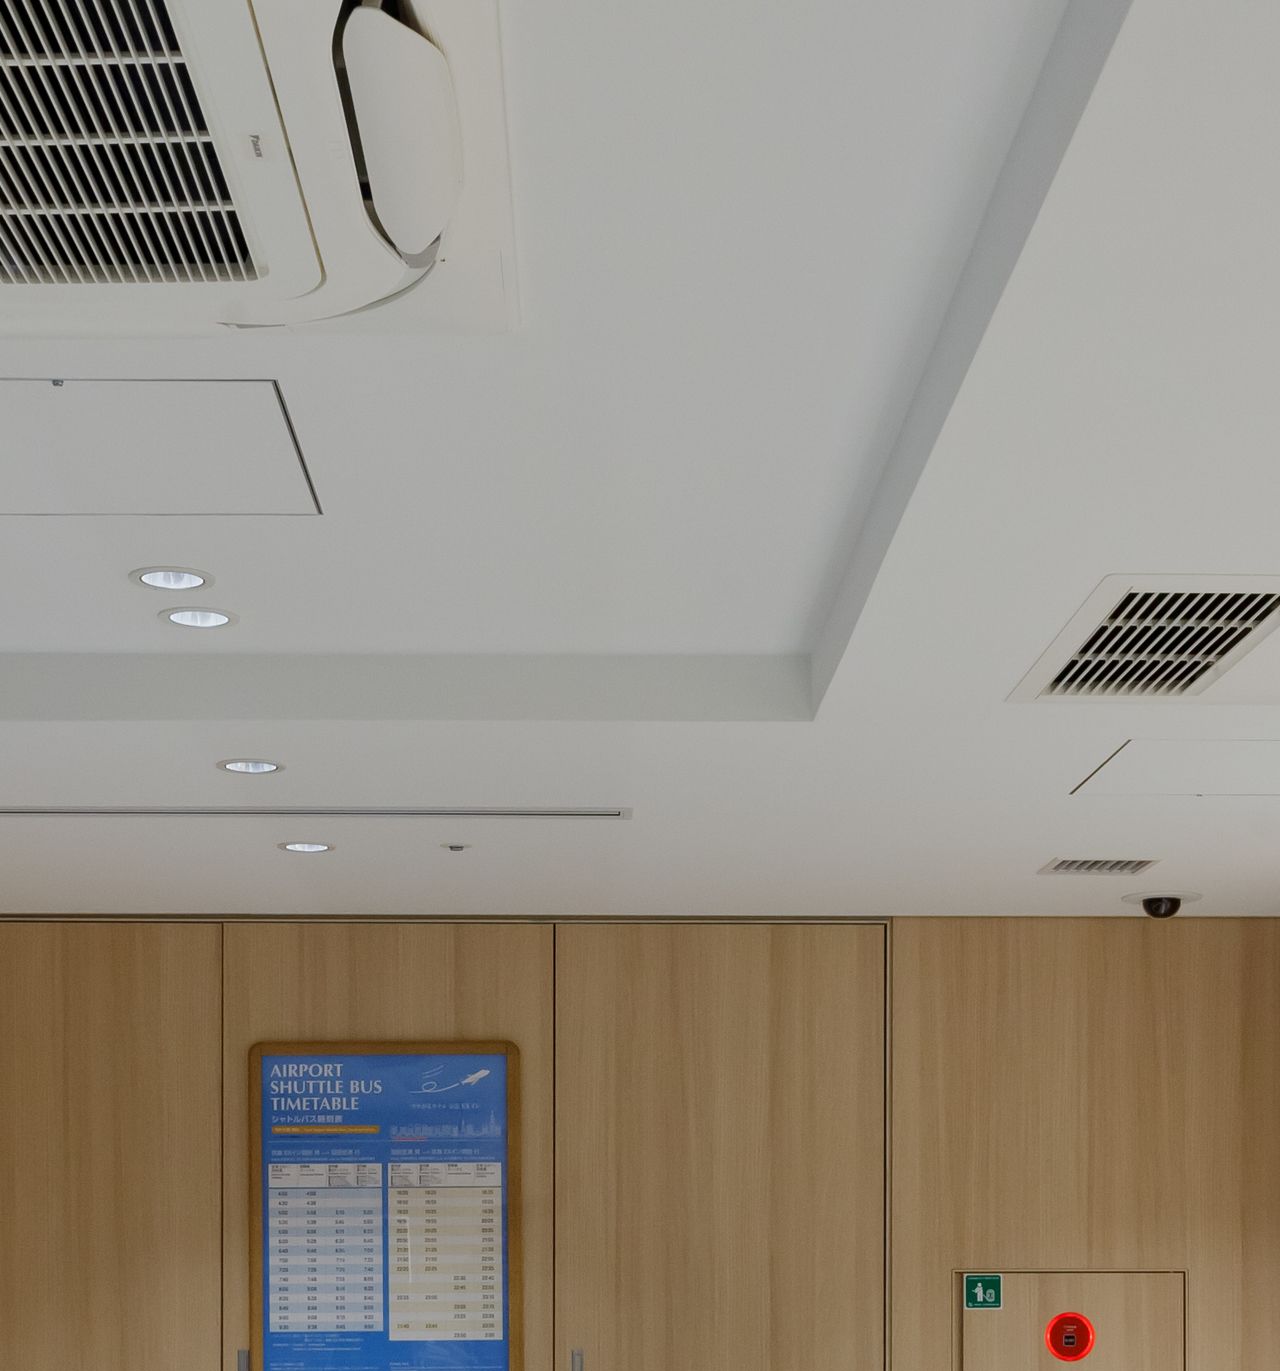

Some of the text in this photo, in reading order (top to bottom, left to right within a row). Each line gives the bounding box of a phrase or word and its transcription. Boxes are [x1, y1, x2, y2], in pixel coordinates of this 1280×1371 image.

[270, 1063, 344, 1078] AIRPORT
[270, 1079, 382, 1094] SHUTTLE BUS
[270, 1097, 360, 1111] TIMETABLE
